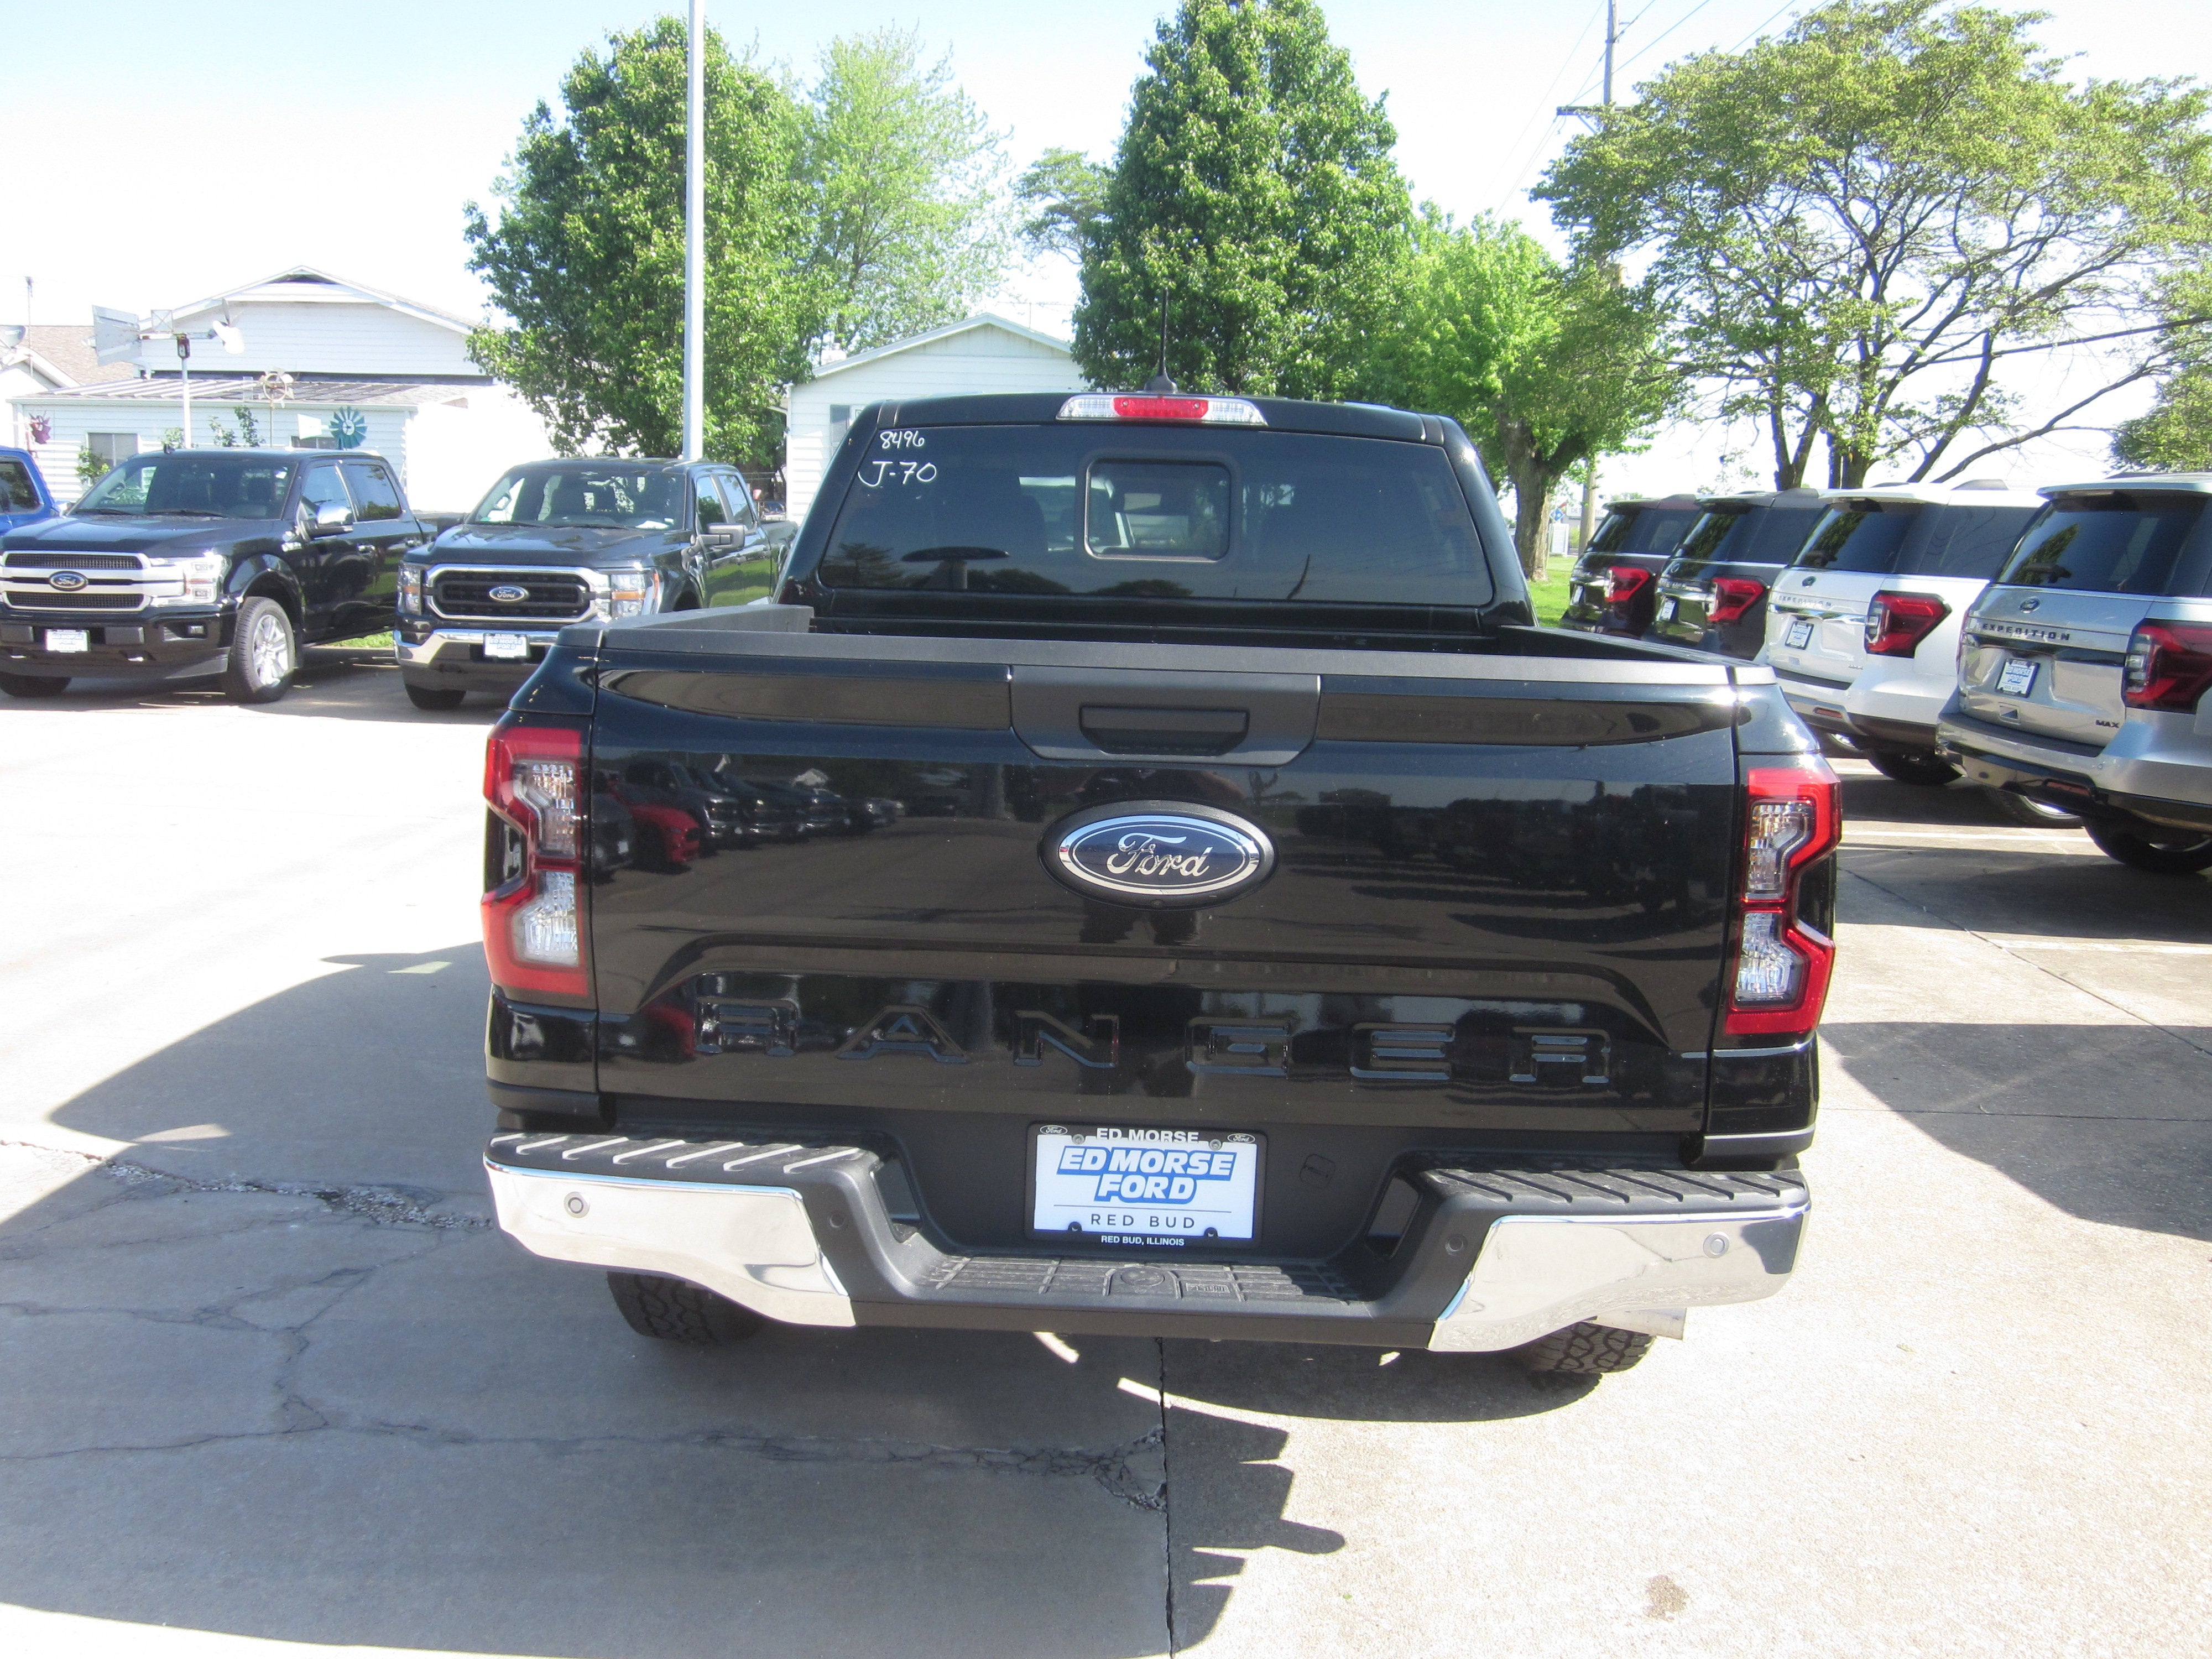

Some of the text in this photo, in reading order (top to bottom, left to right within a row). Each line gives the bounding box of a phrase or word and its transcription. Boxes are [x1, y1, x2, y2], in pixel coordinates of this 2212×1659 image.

[880, 431, 925, 448] 8496
[858, 461, 937, 487] J-70
[497, 589, 516, 598] Ford
[1983, 623, 2070, 640] EXPEDITION
[2095, 719, 2120, 728] MAX
[1107, 832, 1213, 877] Ford
[693, 996, 1610, 1083] RANGER
[1097, 1128, 1199, 1143] ED MORSE
[1057, 1146, 1235, 1179] ED MORSE
[1095, 1173, 1196, 1202] FORD
[1091, 1214, 1194, 1228] RED BUD
[1122, 1236, 1145, 1245] BUD,
[1146, 1237, 1185, 1246] ILLINOIS
